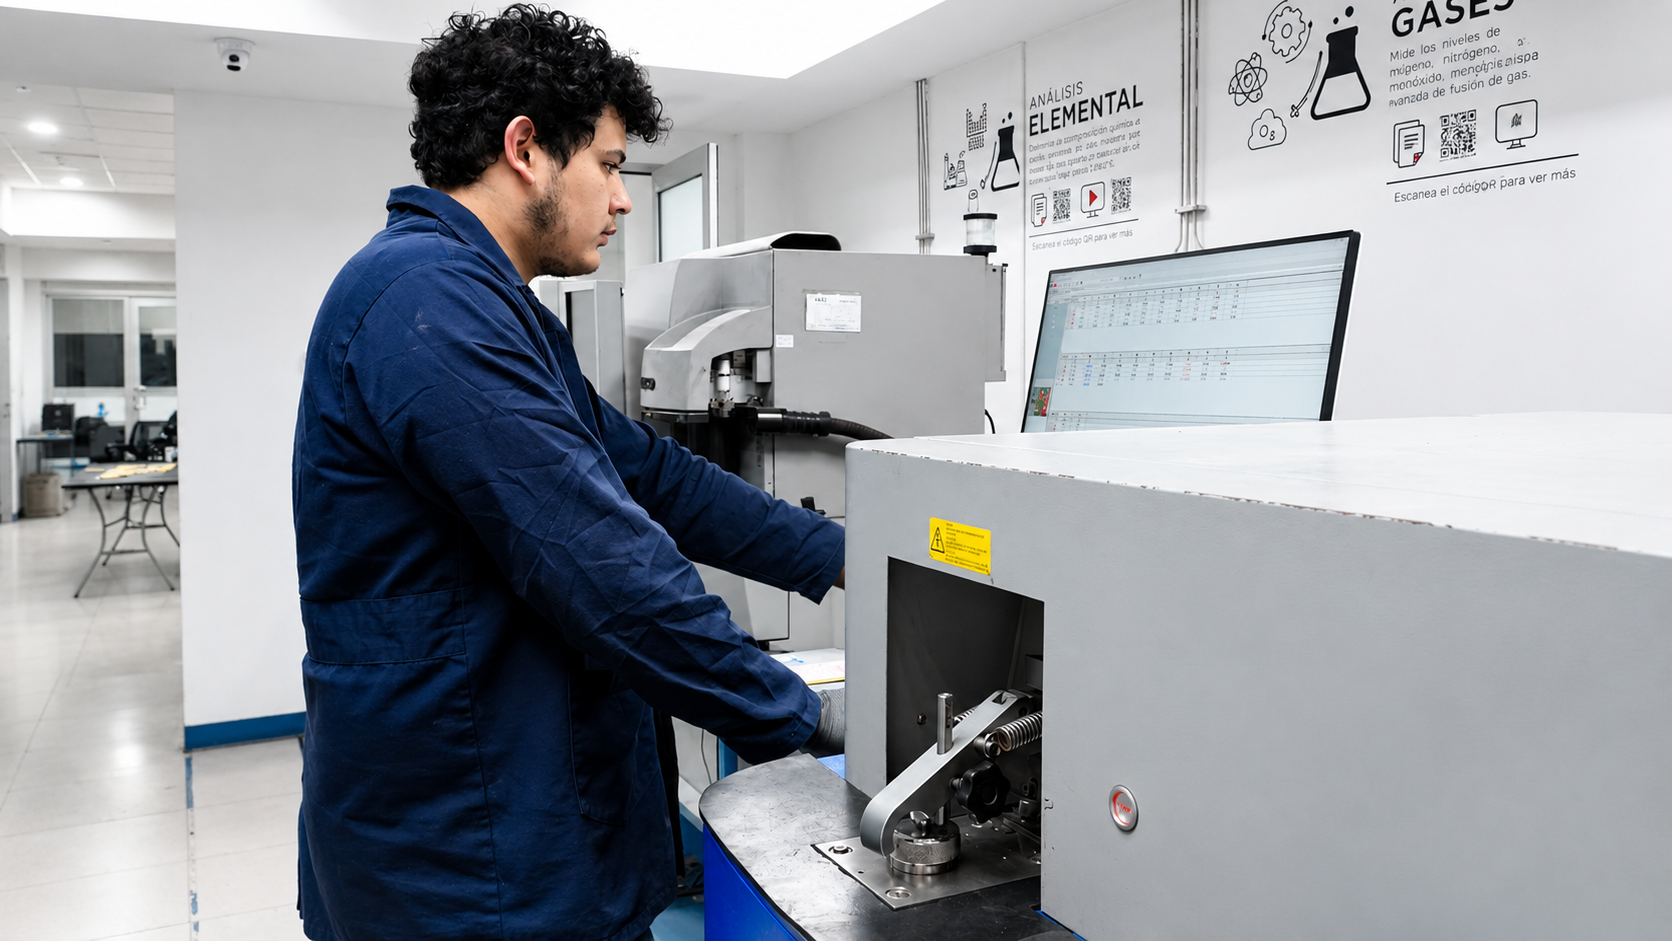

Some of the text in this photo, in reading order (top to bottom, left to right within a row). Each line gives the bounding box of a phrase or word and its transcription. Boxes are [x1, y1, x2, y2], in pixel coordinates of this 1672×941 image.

[1389, 26, 1501, 62] Mide los niveles de
[1029, 81, 1083, 110] ANÁLISIS
[1432, 86, 1446, 98] de
[1450, 79, 1484, 95] fusión
[1488, 74, 1503, 87] de
[1506, 69, 1532, 85] gas.
[1029, 85, 1144, 137] ELEMENTAL
[1394, 188, 1437, 203] Escanea
[1440, 185, 1450, 196] el
[1500, 176, 1526, 190] para
[1529, 172, 1547, 184] ver
[1551, 168, 1576, 181] más
